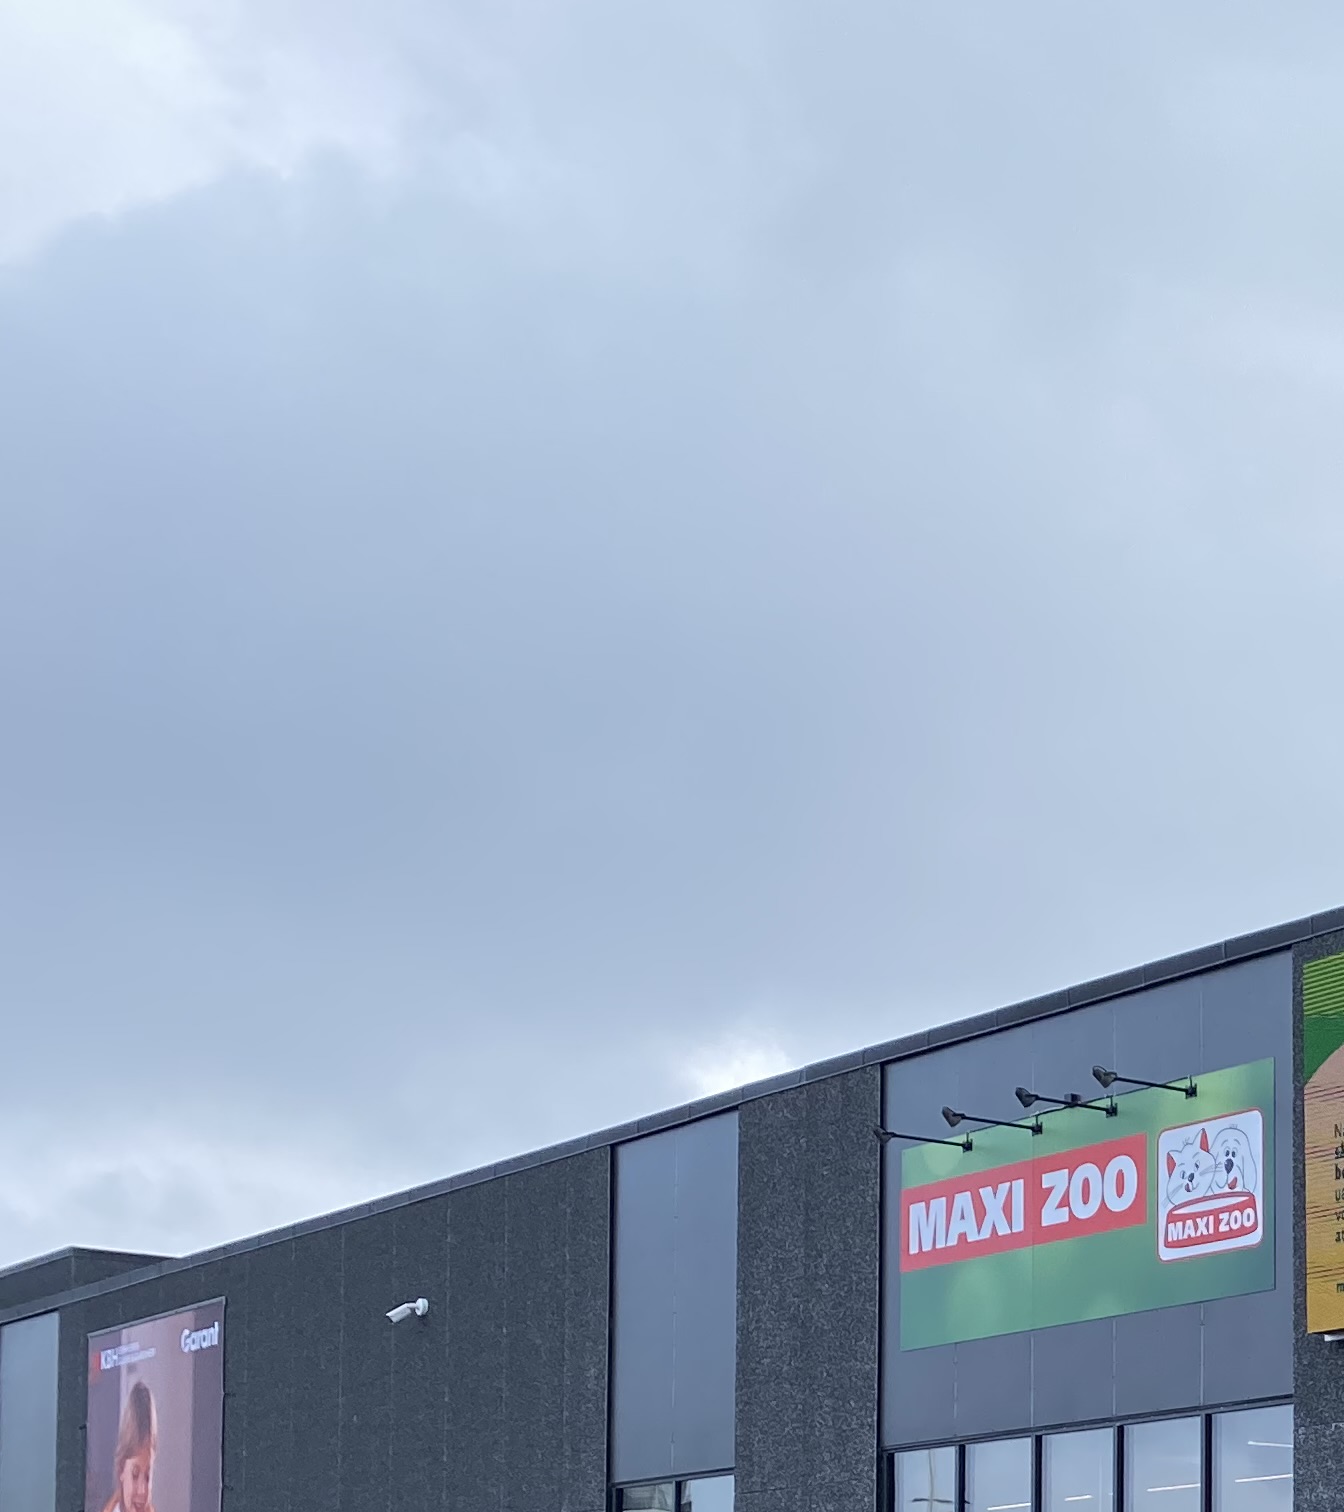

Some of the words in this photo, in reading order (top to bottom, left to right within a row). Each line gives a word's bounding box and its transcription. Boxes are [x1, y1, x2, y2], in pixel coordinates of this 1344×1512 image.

[908, 1178, 1025, 1255] MAXI
[1041, 1154, 1138, 1228] ZOO
[1167, 1213, 1214, 1243] MAXI
[1218, 1206, 1256, 1234] ZOO
